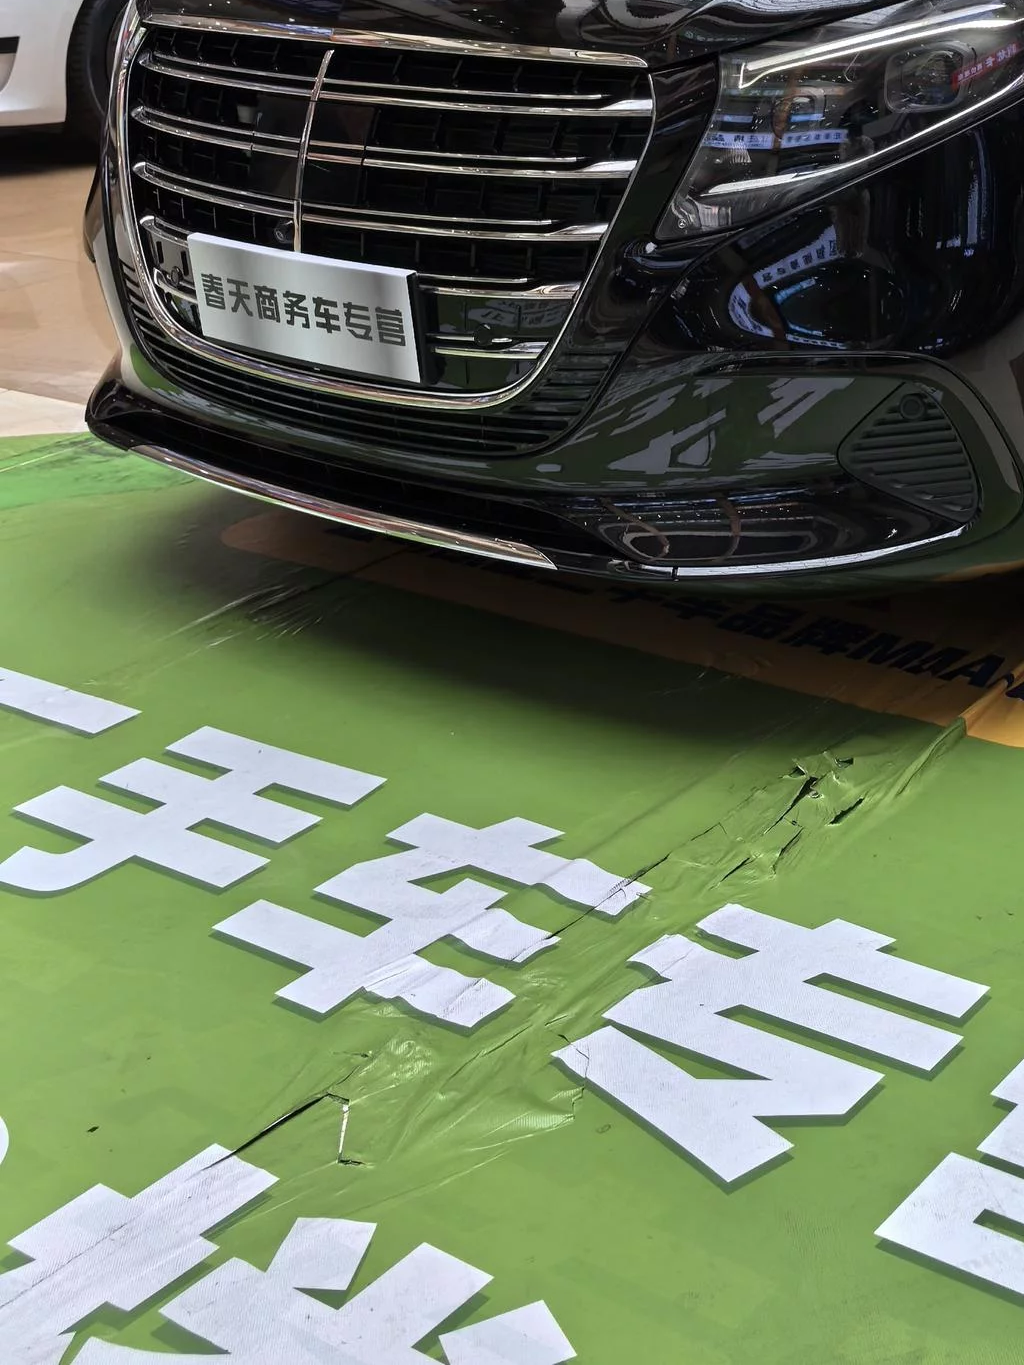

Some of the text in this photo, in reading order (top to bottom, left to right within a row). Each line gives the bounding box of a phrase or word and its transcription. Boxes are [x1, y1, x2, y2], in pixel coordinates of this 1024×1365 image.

[200, 273, 407, 347] 春天商务车专营
